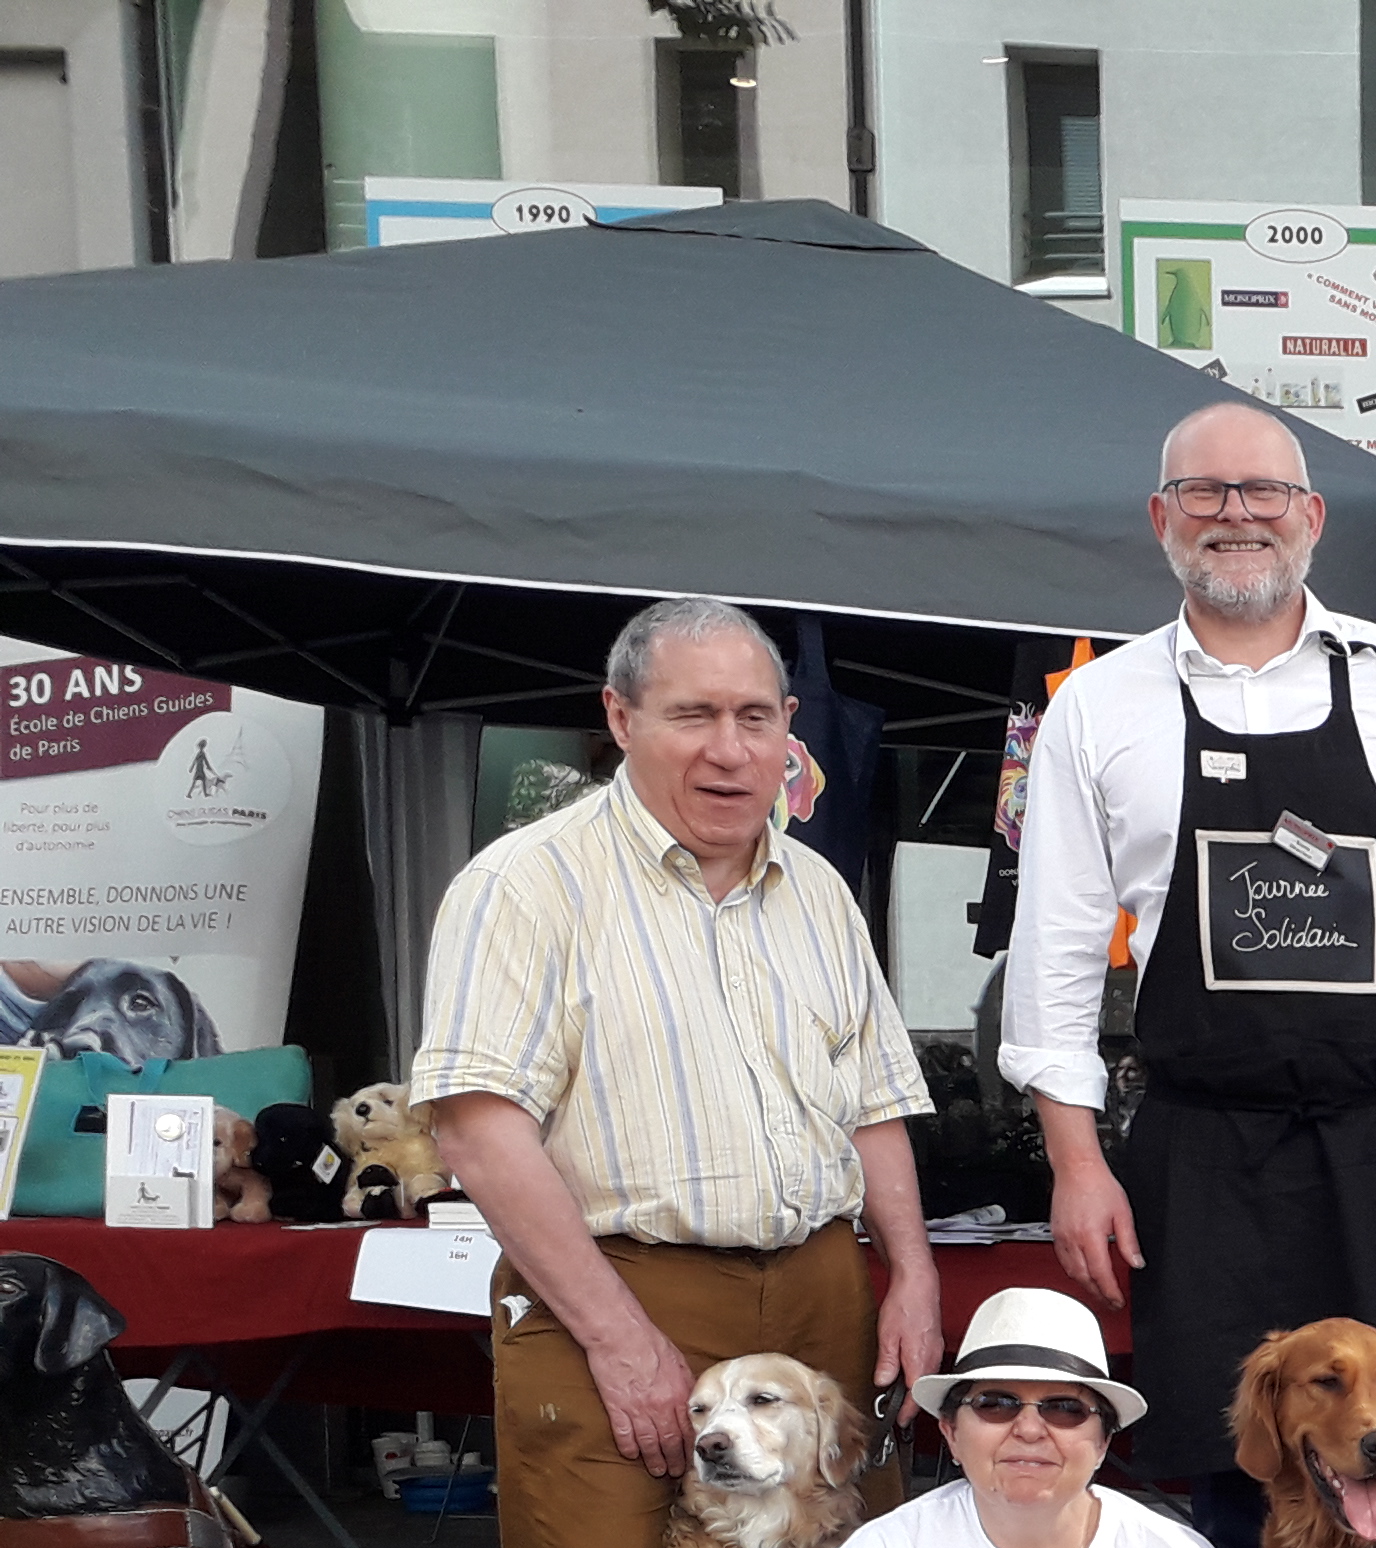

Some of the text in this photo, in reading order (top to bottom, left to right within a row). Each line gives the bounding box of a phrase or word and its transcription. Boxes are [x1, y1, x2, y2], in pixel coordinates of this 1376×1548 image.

[515, 203, 571, 224] 1990
[1266, 225, 1324, 245] 2000
[1223, 294, 1276, 305] MONOPRIX
[1316, 275, 1370, 306] COMMENT
[1329, 294, 1358, 314] SANS
[1286, 338, 1363, 356] NATURALIA
[8, 664, 143, 707] 30 ANS
[10, 691, 214, 735] École de Chiens Guides
[10, 737, 81, 761] de Paris
[1, 883, 248, 906] ENSEMBLE, DONNONS UNE
[1229, 861, 1330, 918] Journée
[6, 917, 65, 935] AUTRE
[72, 915, 130, 933] VISION
[137, 914, 160, 932] DE
[166, 913, 187, 931] LA
[190, 912, 218, 930] VIE
[1232, 908, 1359, 952] Solidaire
